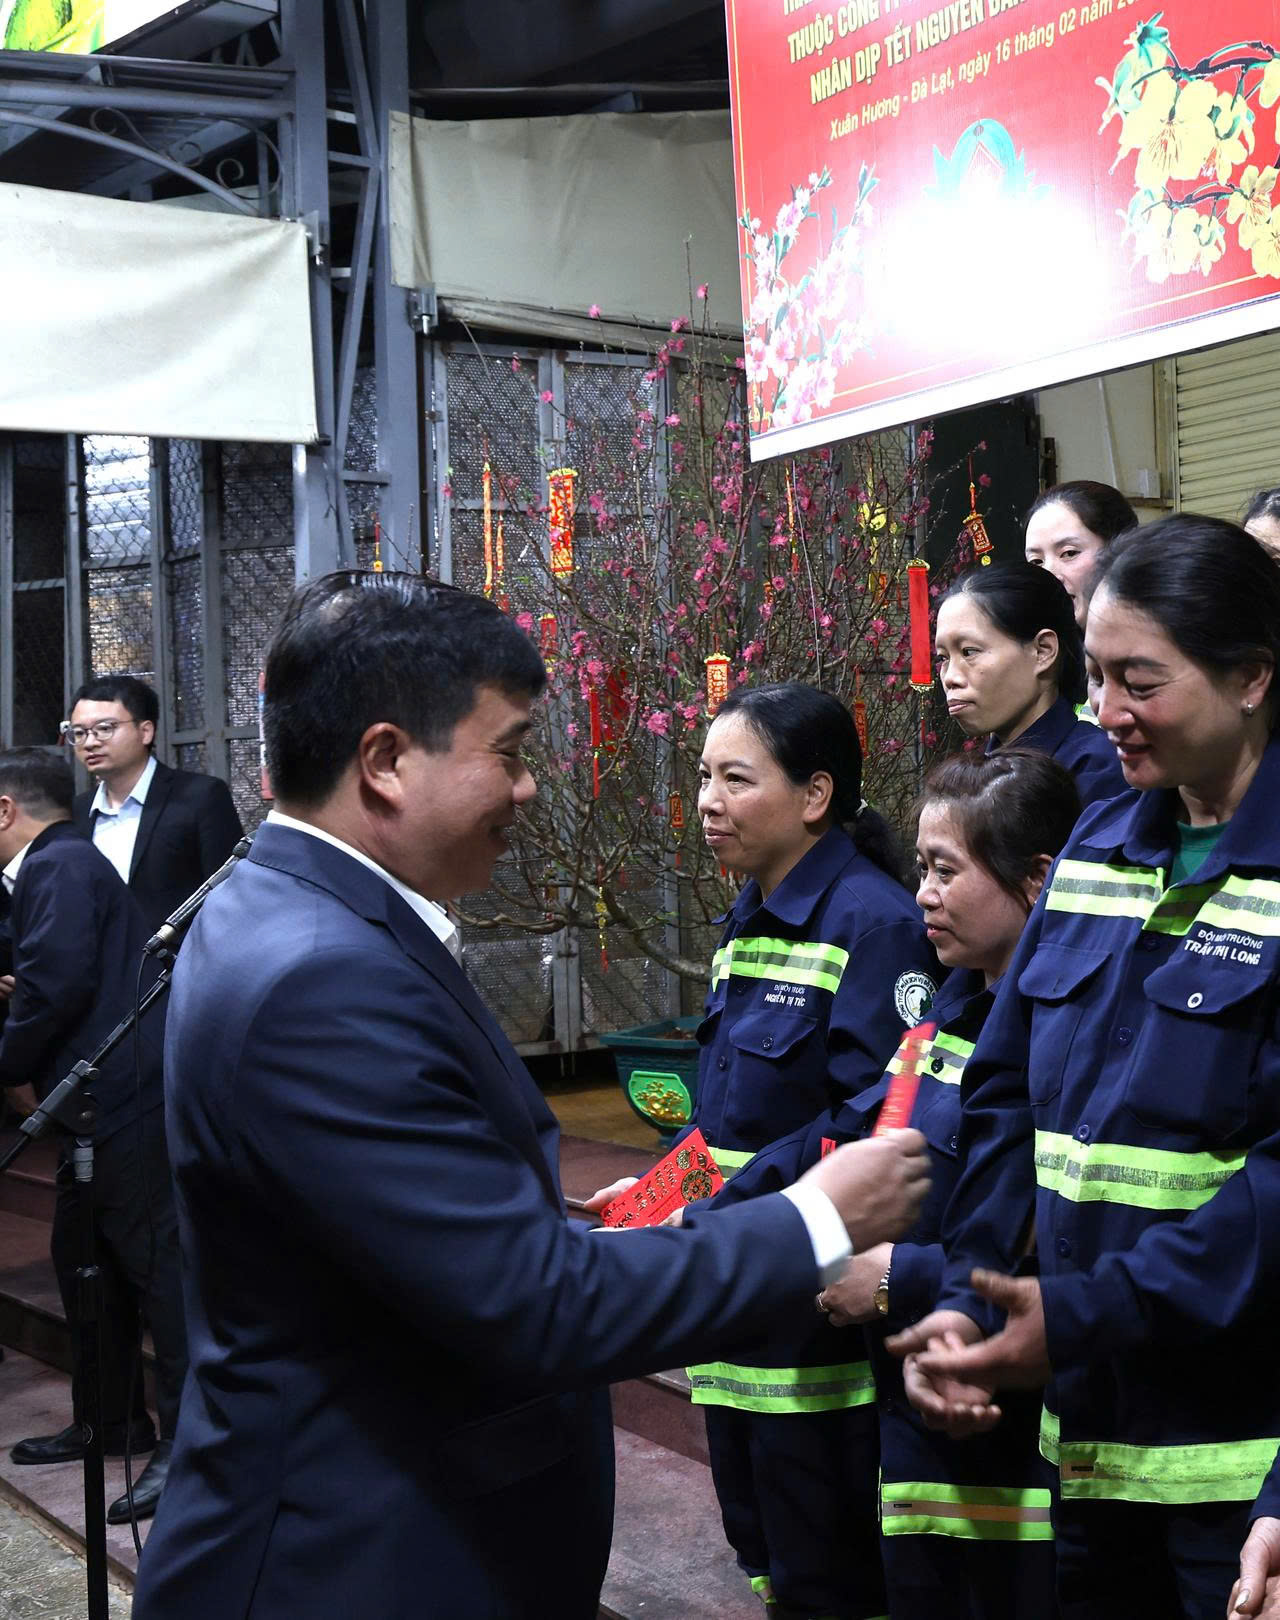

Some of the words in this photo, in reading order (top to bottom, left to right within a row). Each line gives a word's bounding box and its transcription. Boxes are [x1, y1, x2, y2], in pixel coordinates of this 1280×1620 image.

[787, 13, 834, 64] THUỘC
[810, 57, 852, 105] NHÂN
[855, 42, 881, 85] DỊP
[884, 19, 912, 67] TẾT
[829, 112, 859, 141] Xuân
[861, 94, 900, 127] Hương
[911, 77, 928, 104] Đà
[958, 51, 992, 84] ngày
[995, 38, 1011, 65] 16
[1014, 24, 1055, 57] tháng
[1058, 7, 1077, 36] 02
[1230, 948, 1261, 965] LONG
